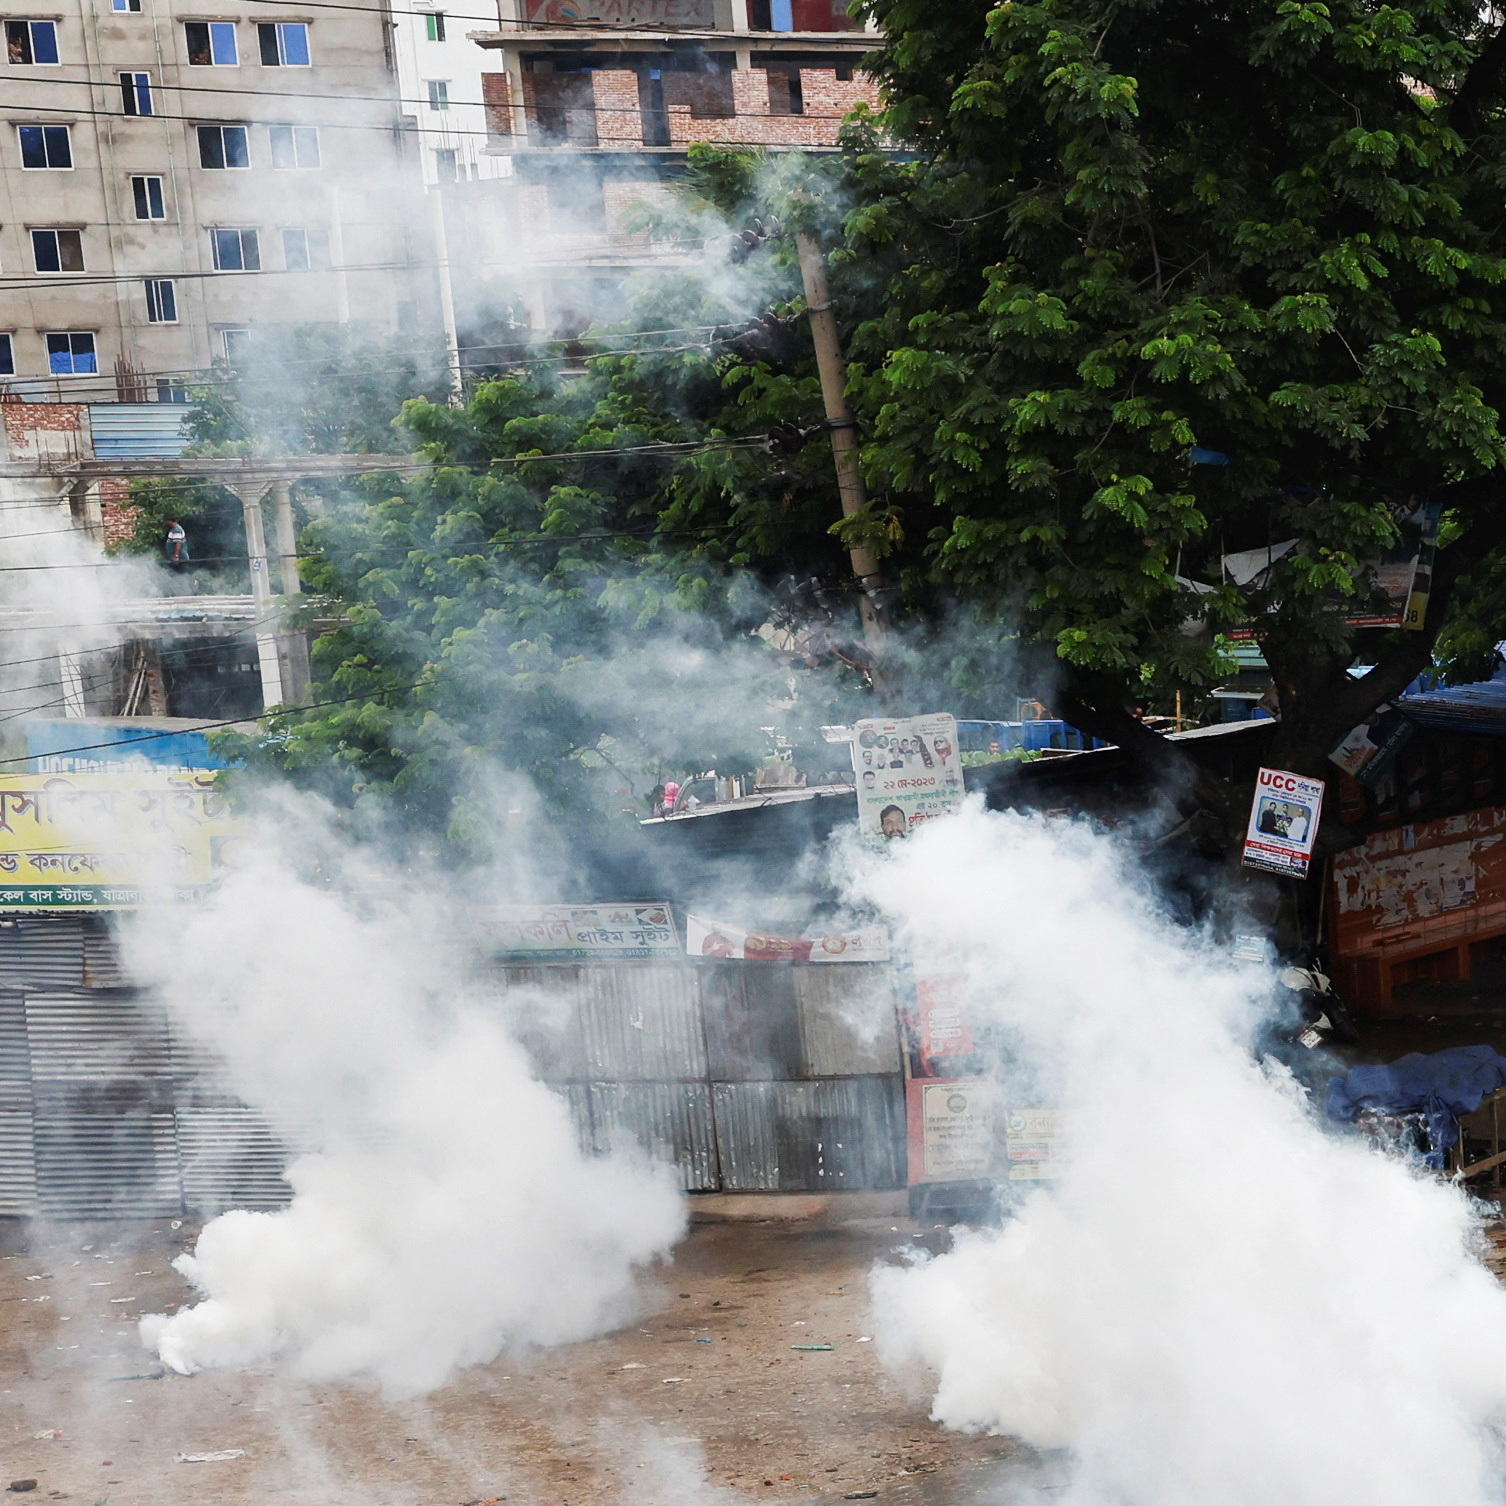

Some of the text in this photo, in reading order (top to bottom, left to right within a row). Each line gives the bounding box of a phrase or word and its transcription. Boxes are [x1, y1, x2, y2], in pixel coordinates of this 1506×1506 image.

[1258, 771, 1297, 793] UCC
[28, 888, 53, 904] বাস
[576, 926, 624, 945] প্রাইম
[629, 925, 671, 947] সুইট
